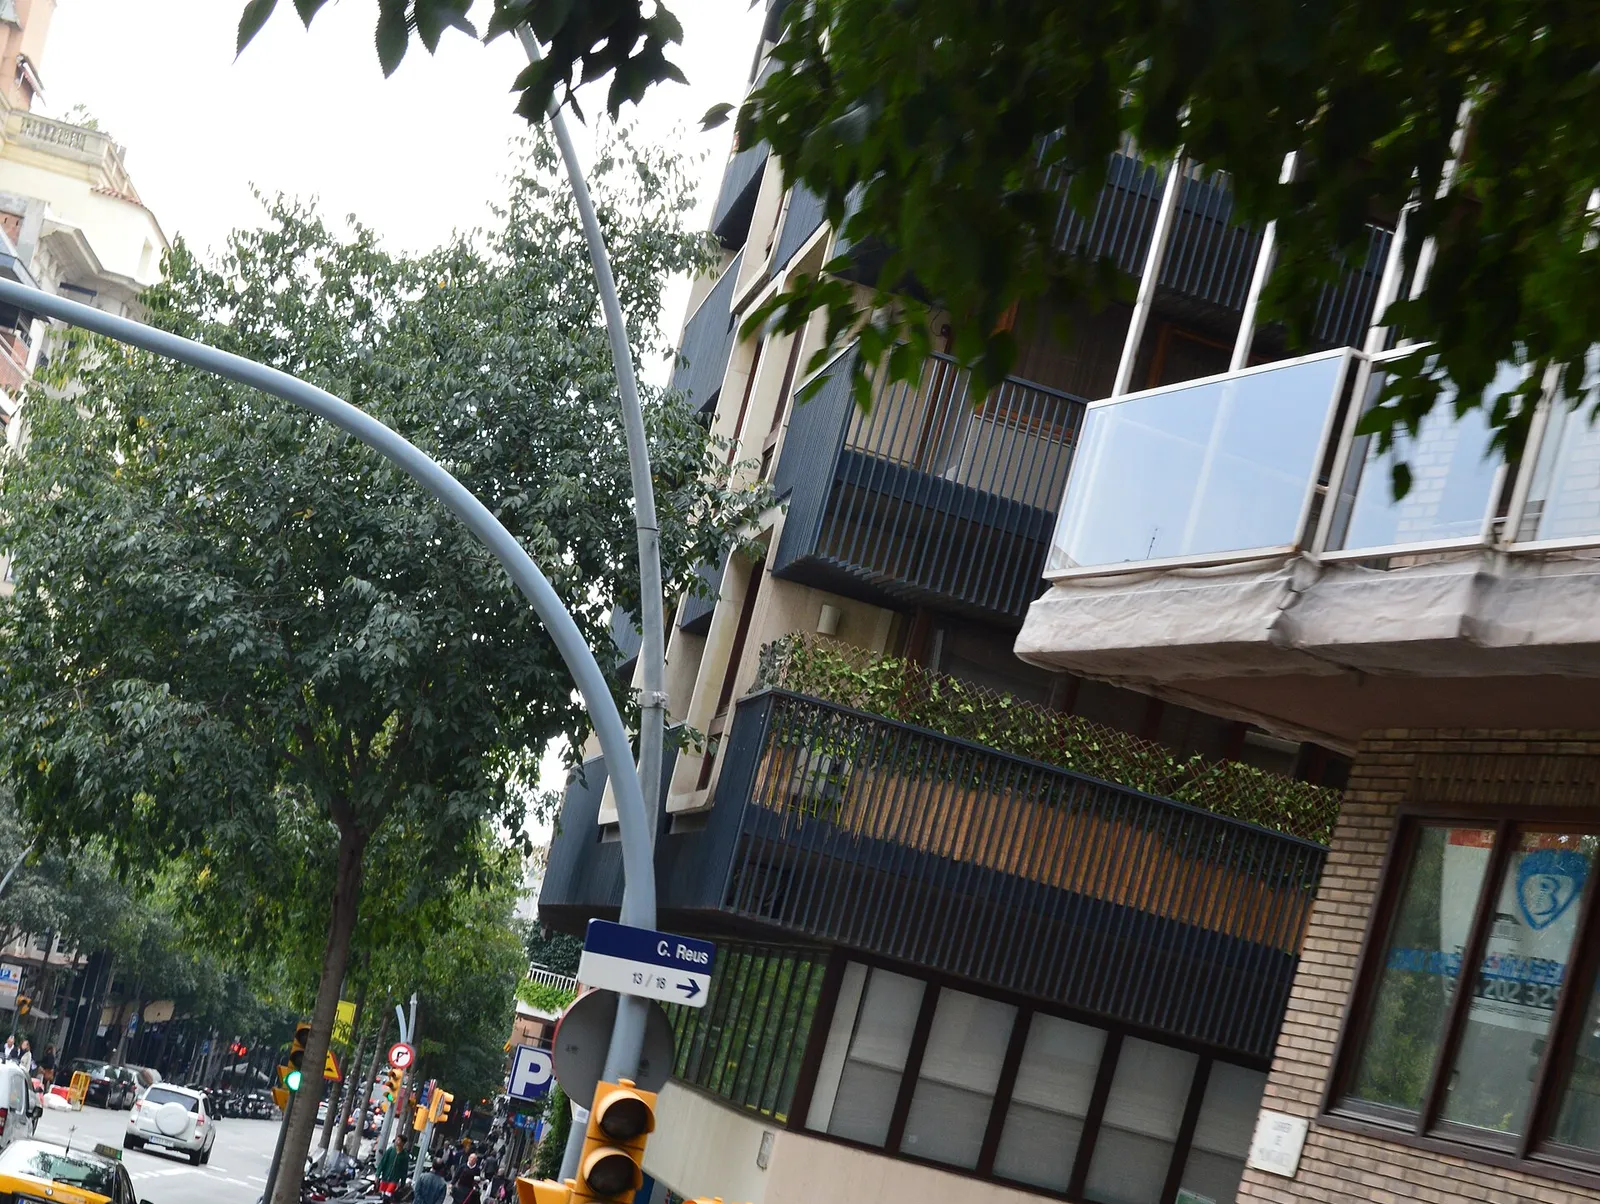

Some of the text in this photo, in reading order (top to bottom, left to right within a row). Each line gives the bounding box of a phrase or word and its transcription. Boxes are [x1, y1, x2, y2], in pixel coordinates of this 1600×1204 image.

[657, 940, 709, 965] C. Reus
[511, 1048, 553, 1096] P
